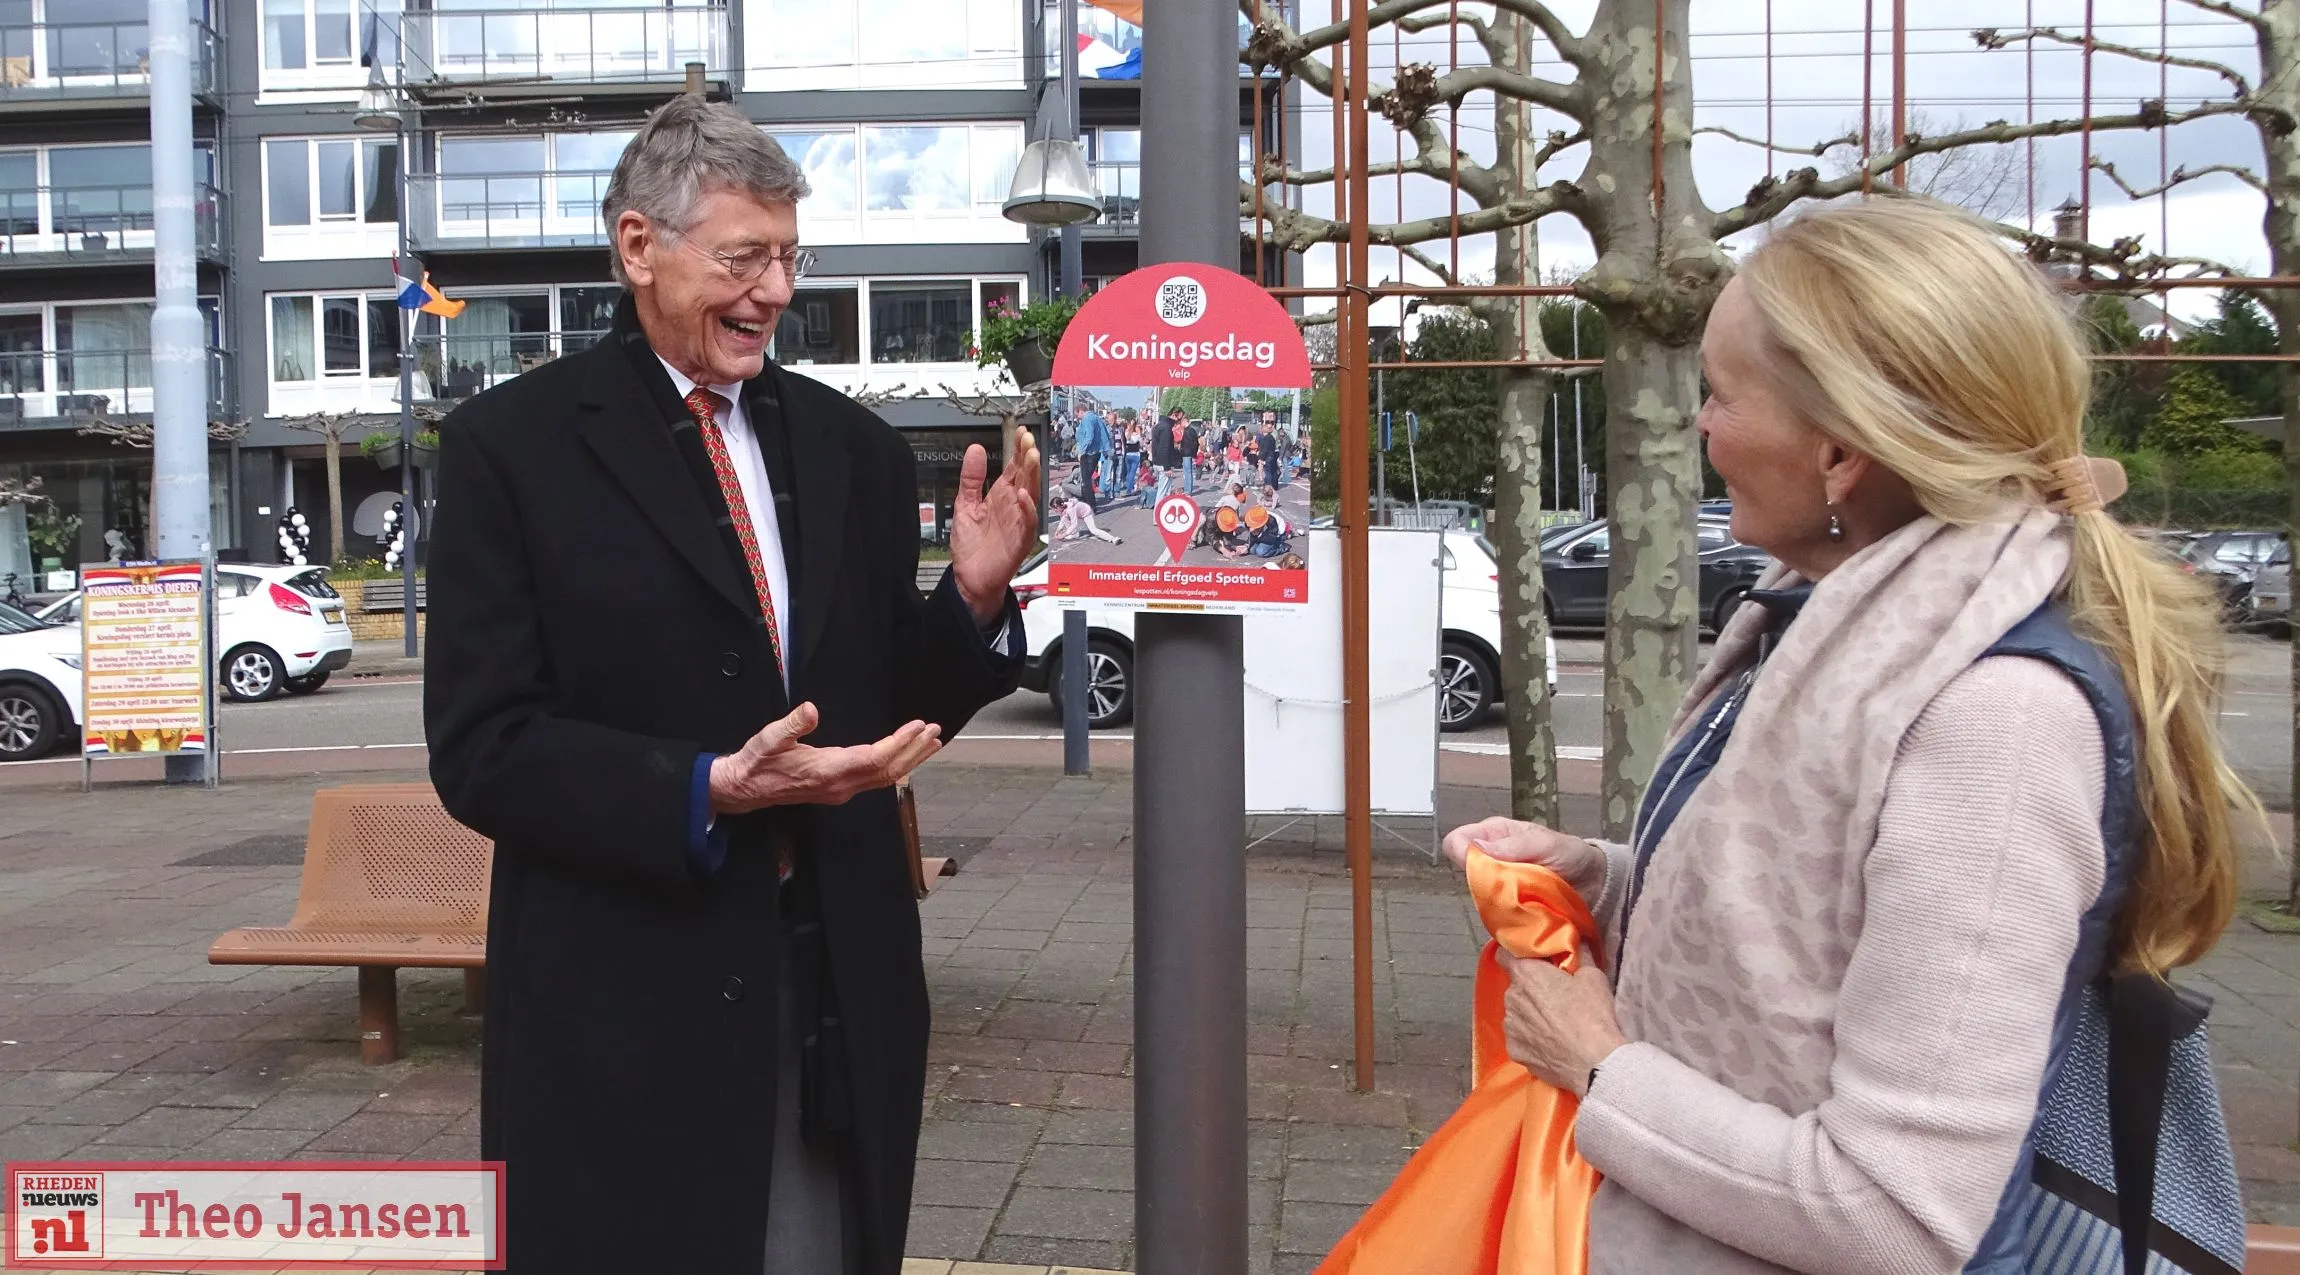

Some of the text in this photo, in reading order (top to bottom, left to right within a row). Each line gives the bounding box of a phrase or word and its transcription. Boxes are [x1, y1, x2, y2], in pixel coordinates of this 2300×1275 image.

[1088, 333, 1275, 368] Koningsdag
[1169, 369, 1191, 381] Velp
[913, 451, 963, 462] ENSIONS
[1089, 569, 1265, 586] Immaterieel Erfgoed Spotten
[87, 582, 199, 597] KONINGSKERMIS DIEREN
[115, 625, 147, 633] Donderdag
[97, 633, 131, 641] Koningsdag
